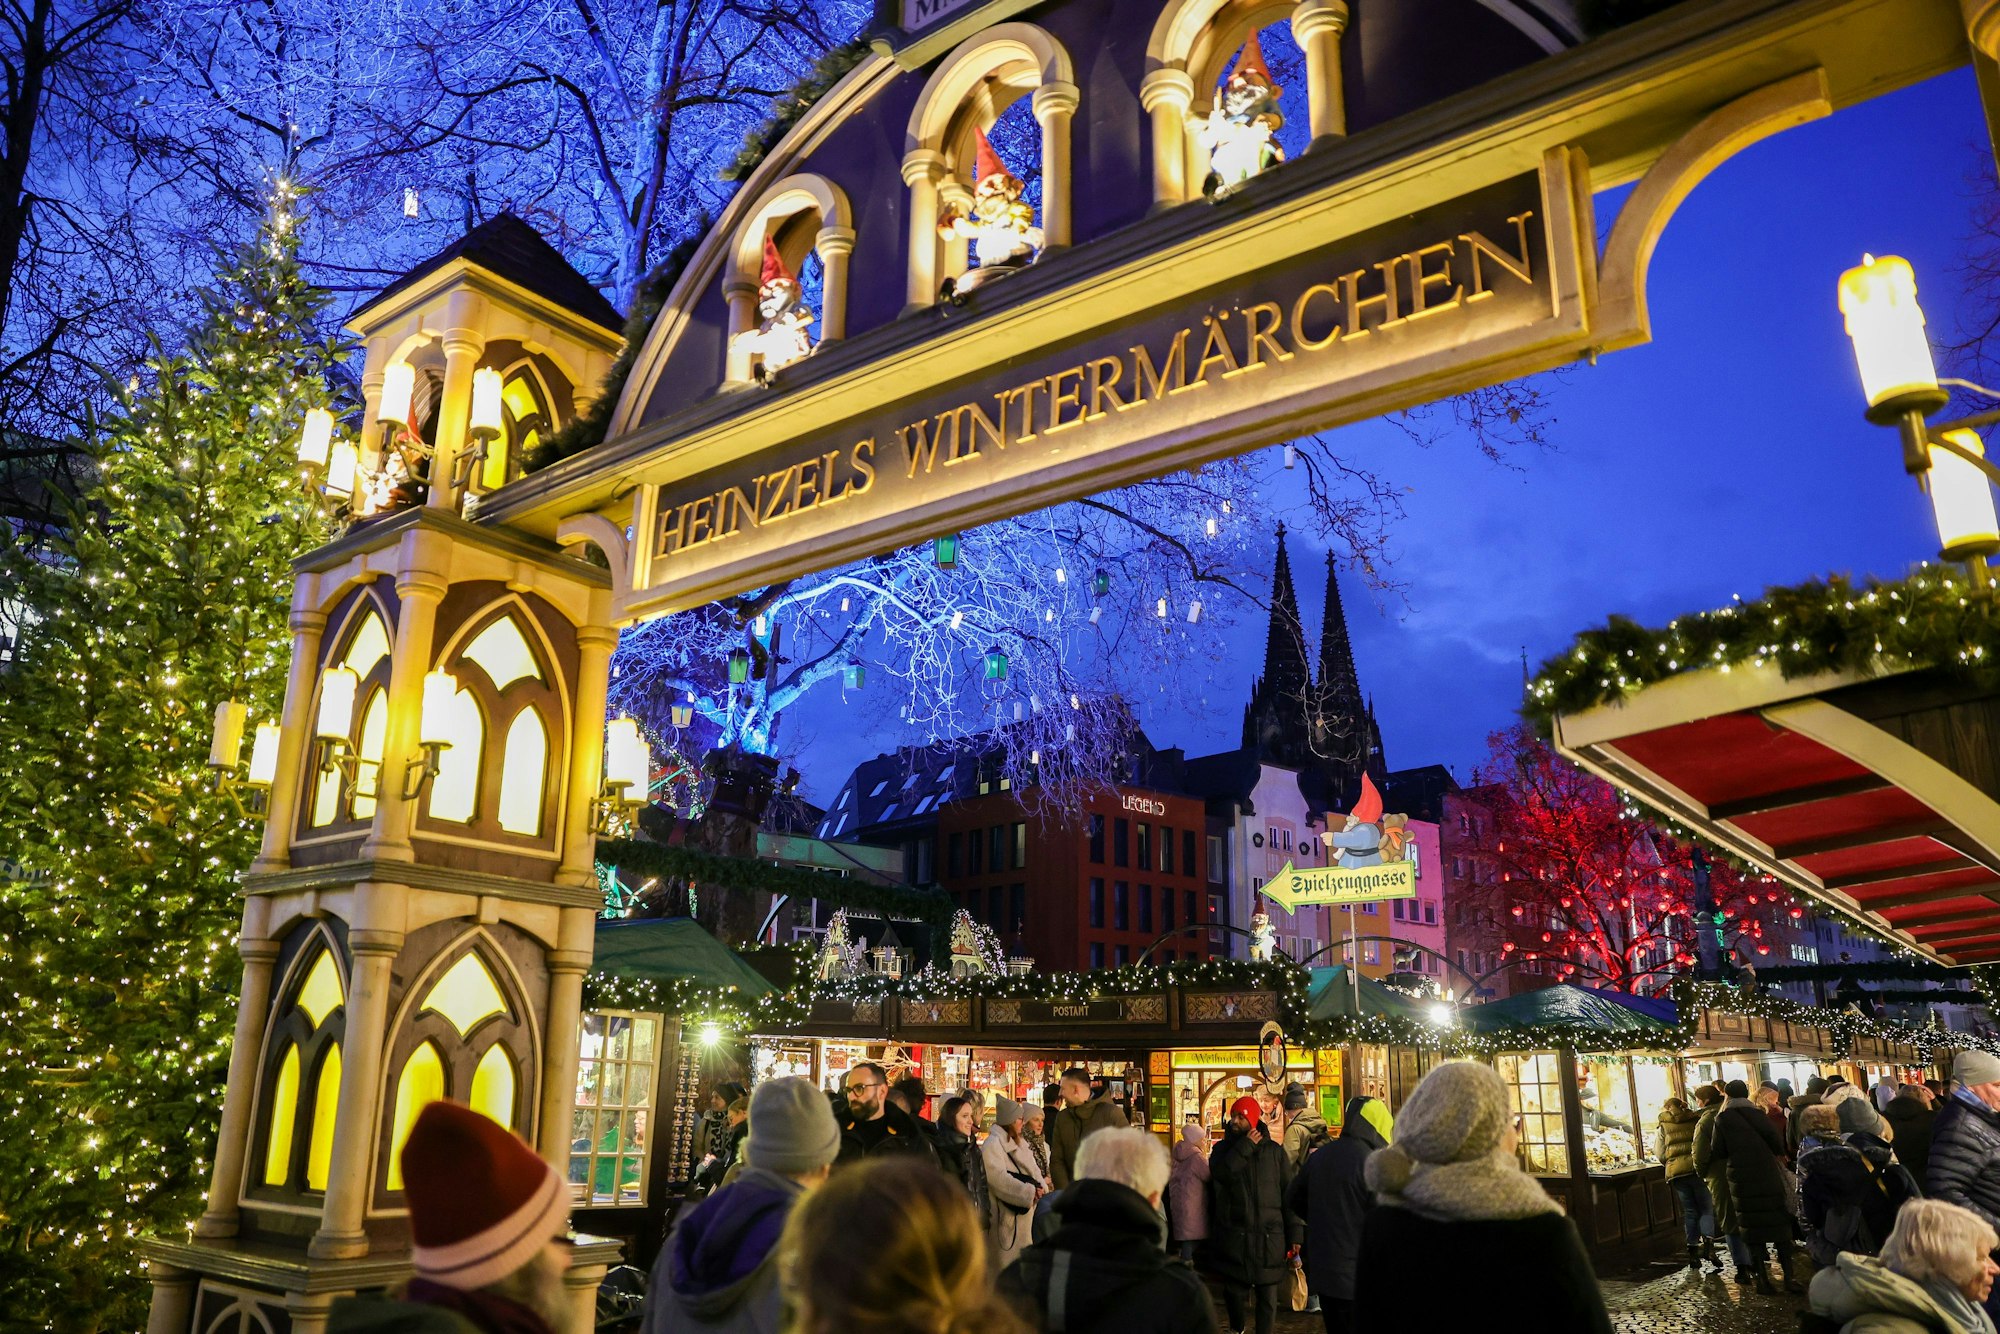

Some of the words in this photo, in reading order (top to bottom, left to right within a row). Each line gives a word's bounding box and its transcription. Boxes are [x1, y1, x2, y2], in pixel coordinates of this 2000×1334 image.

[653, 437, 876, 560] HEINZELS
[895, 210, 1534, 479] WINTERMÄRCHEN
[1291, 868, 1407, 897] Spielzeuggasse
[1053, 1005, 1090, 1017] POSTAMT
